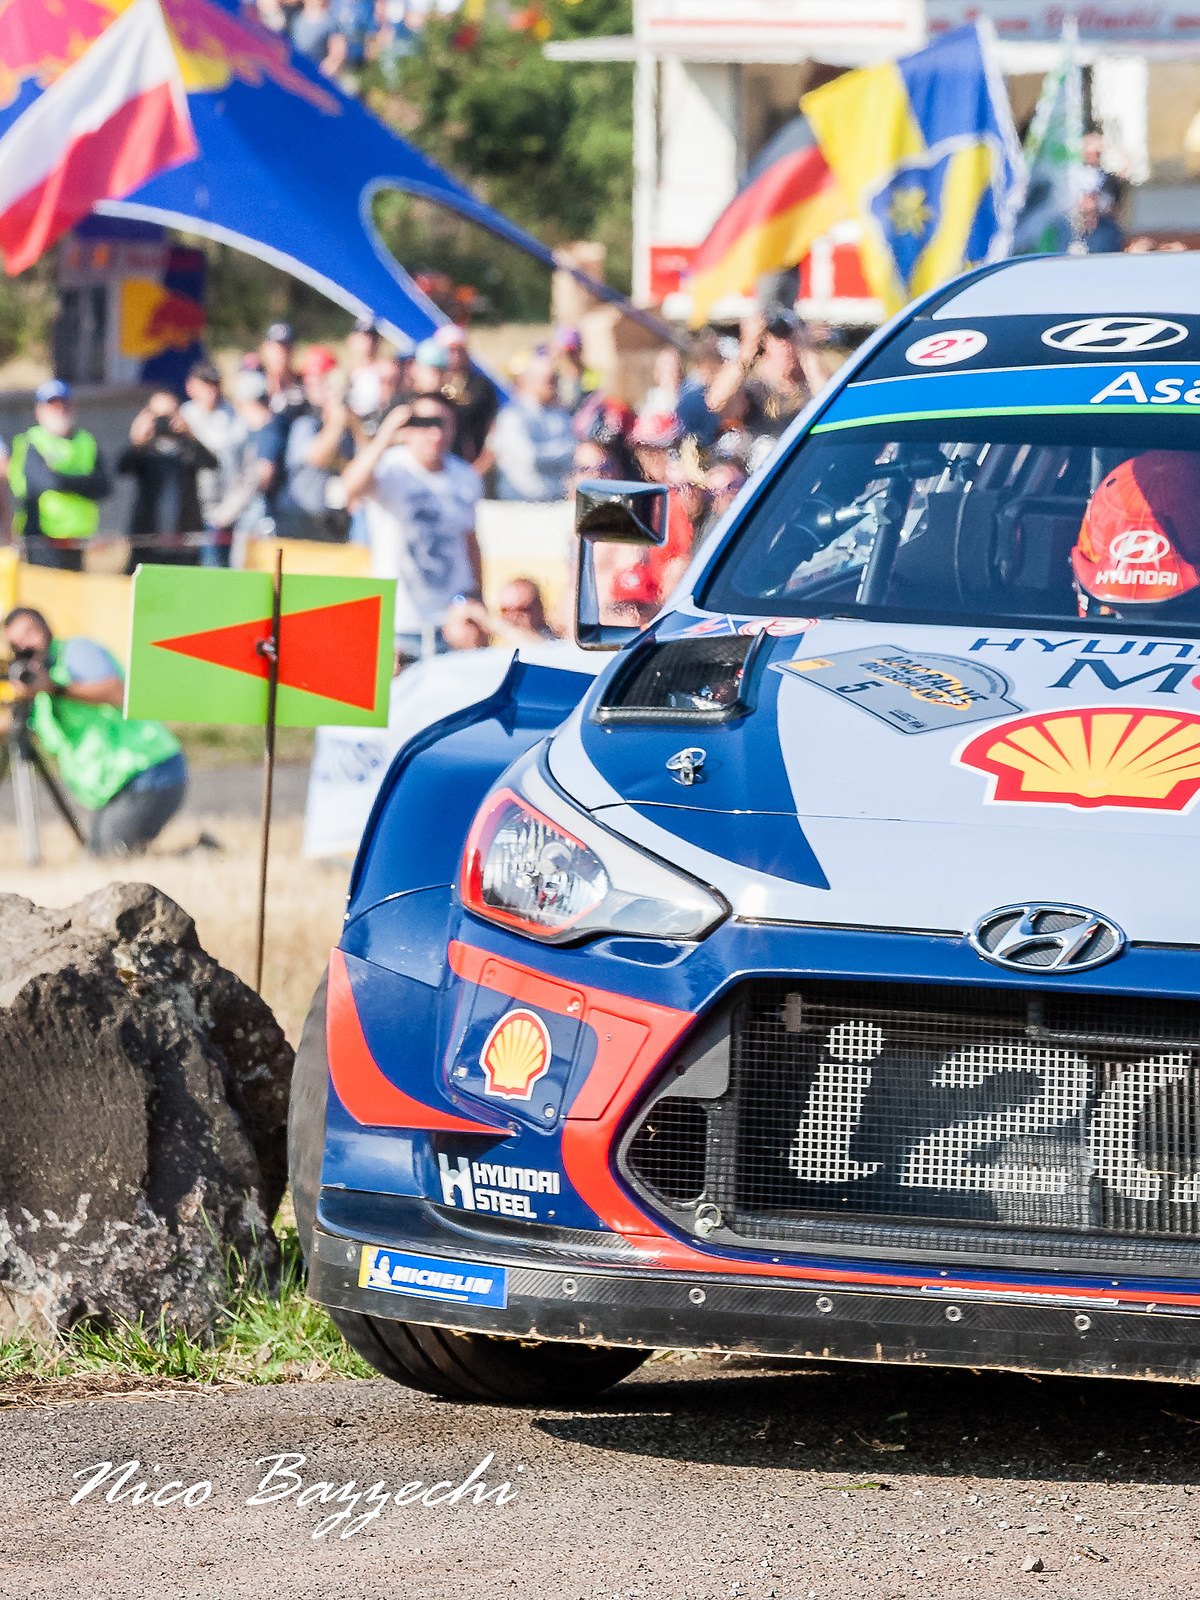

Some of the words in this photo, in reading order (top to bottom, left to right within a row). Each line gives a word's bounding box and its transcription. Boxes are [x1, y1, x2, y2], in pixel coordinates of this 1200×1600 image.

[1095, 570, 1179, 587] HYUNDAI
[835, 680, 884, 694] 5
[471, 1161, 560, 1195] HYUNDAI
[474, 1187, 537, 1219] STEEL
[391, 1266, 494, 1294] MICHELIN
